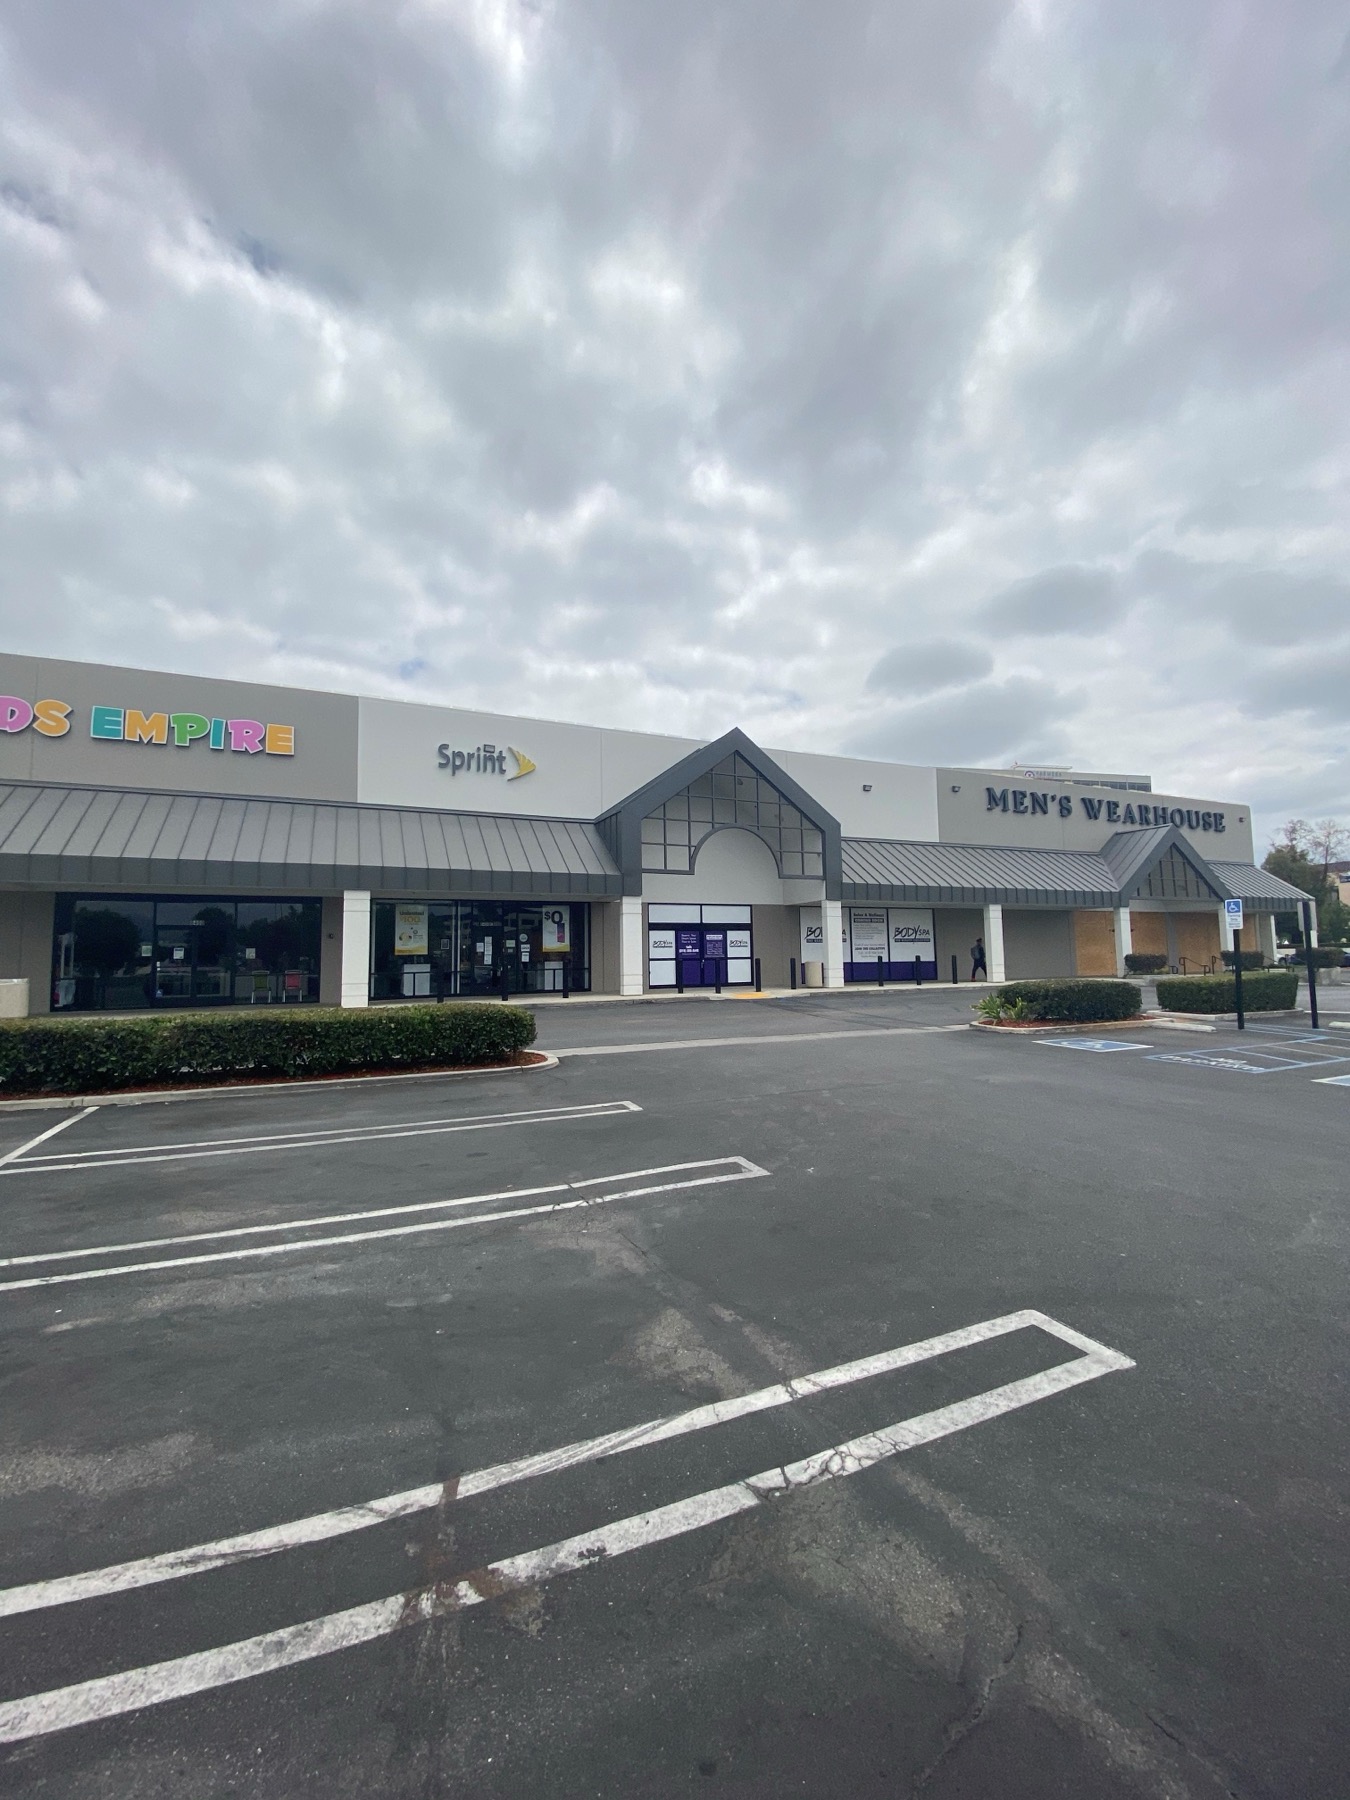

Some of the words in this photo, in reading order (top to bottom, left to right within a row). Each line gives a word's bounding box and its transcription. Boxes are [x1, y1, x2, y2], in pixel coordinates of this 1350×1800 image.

[90, 706, 295, 756] EMPIRE
[438, 744, 507, 777] Sprint
[986, 787, 1073, 818] MEN'S
[1080, 796, 1226, 832] WEARHOUSE
[544, 910, 564, 924] $0
[804, 926, 823, 939] BO
[893, 925, 921, 939] BODY
[918, 928, 930, 936] SPA
